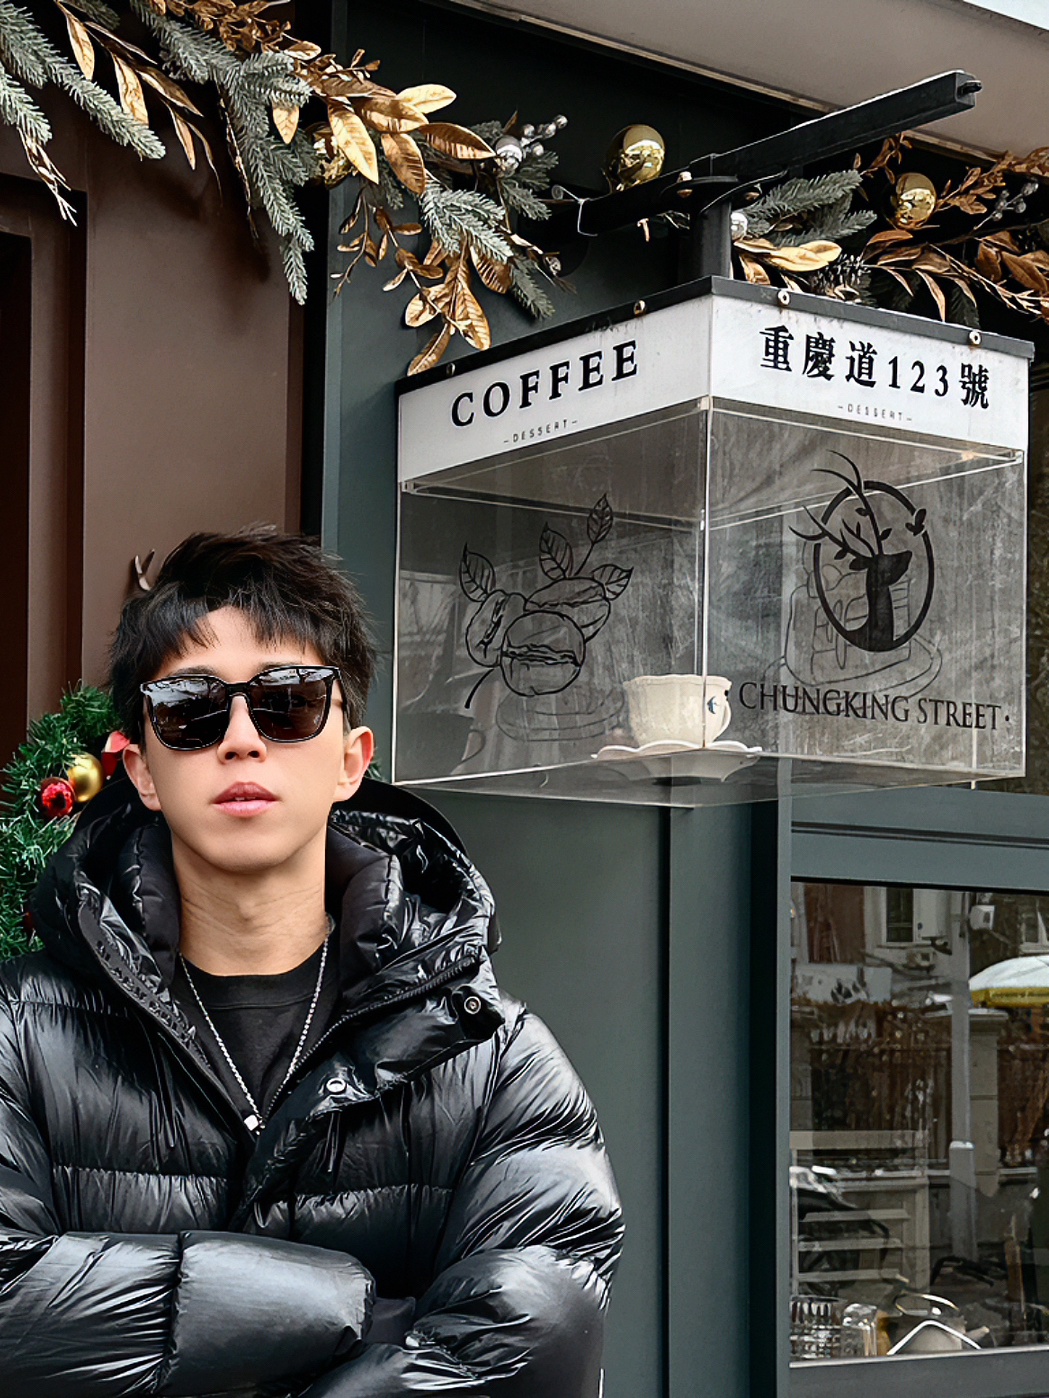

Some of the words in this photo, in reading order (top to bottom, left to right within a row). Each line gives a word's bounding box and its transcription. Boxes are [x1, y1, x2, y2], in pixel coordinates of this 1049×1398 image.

[451, 340, 638, 427] COFFEE
[759, 325, 990, 409] 重慶道123號
[739, 681, 910, 722] CHUNGKING
[917, 697, 1002, 730] STREET
